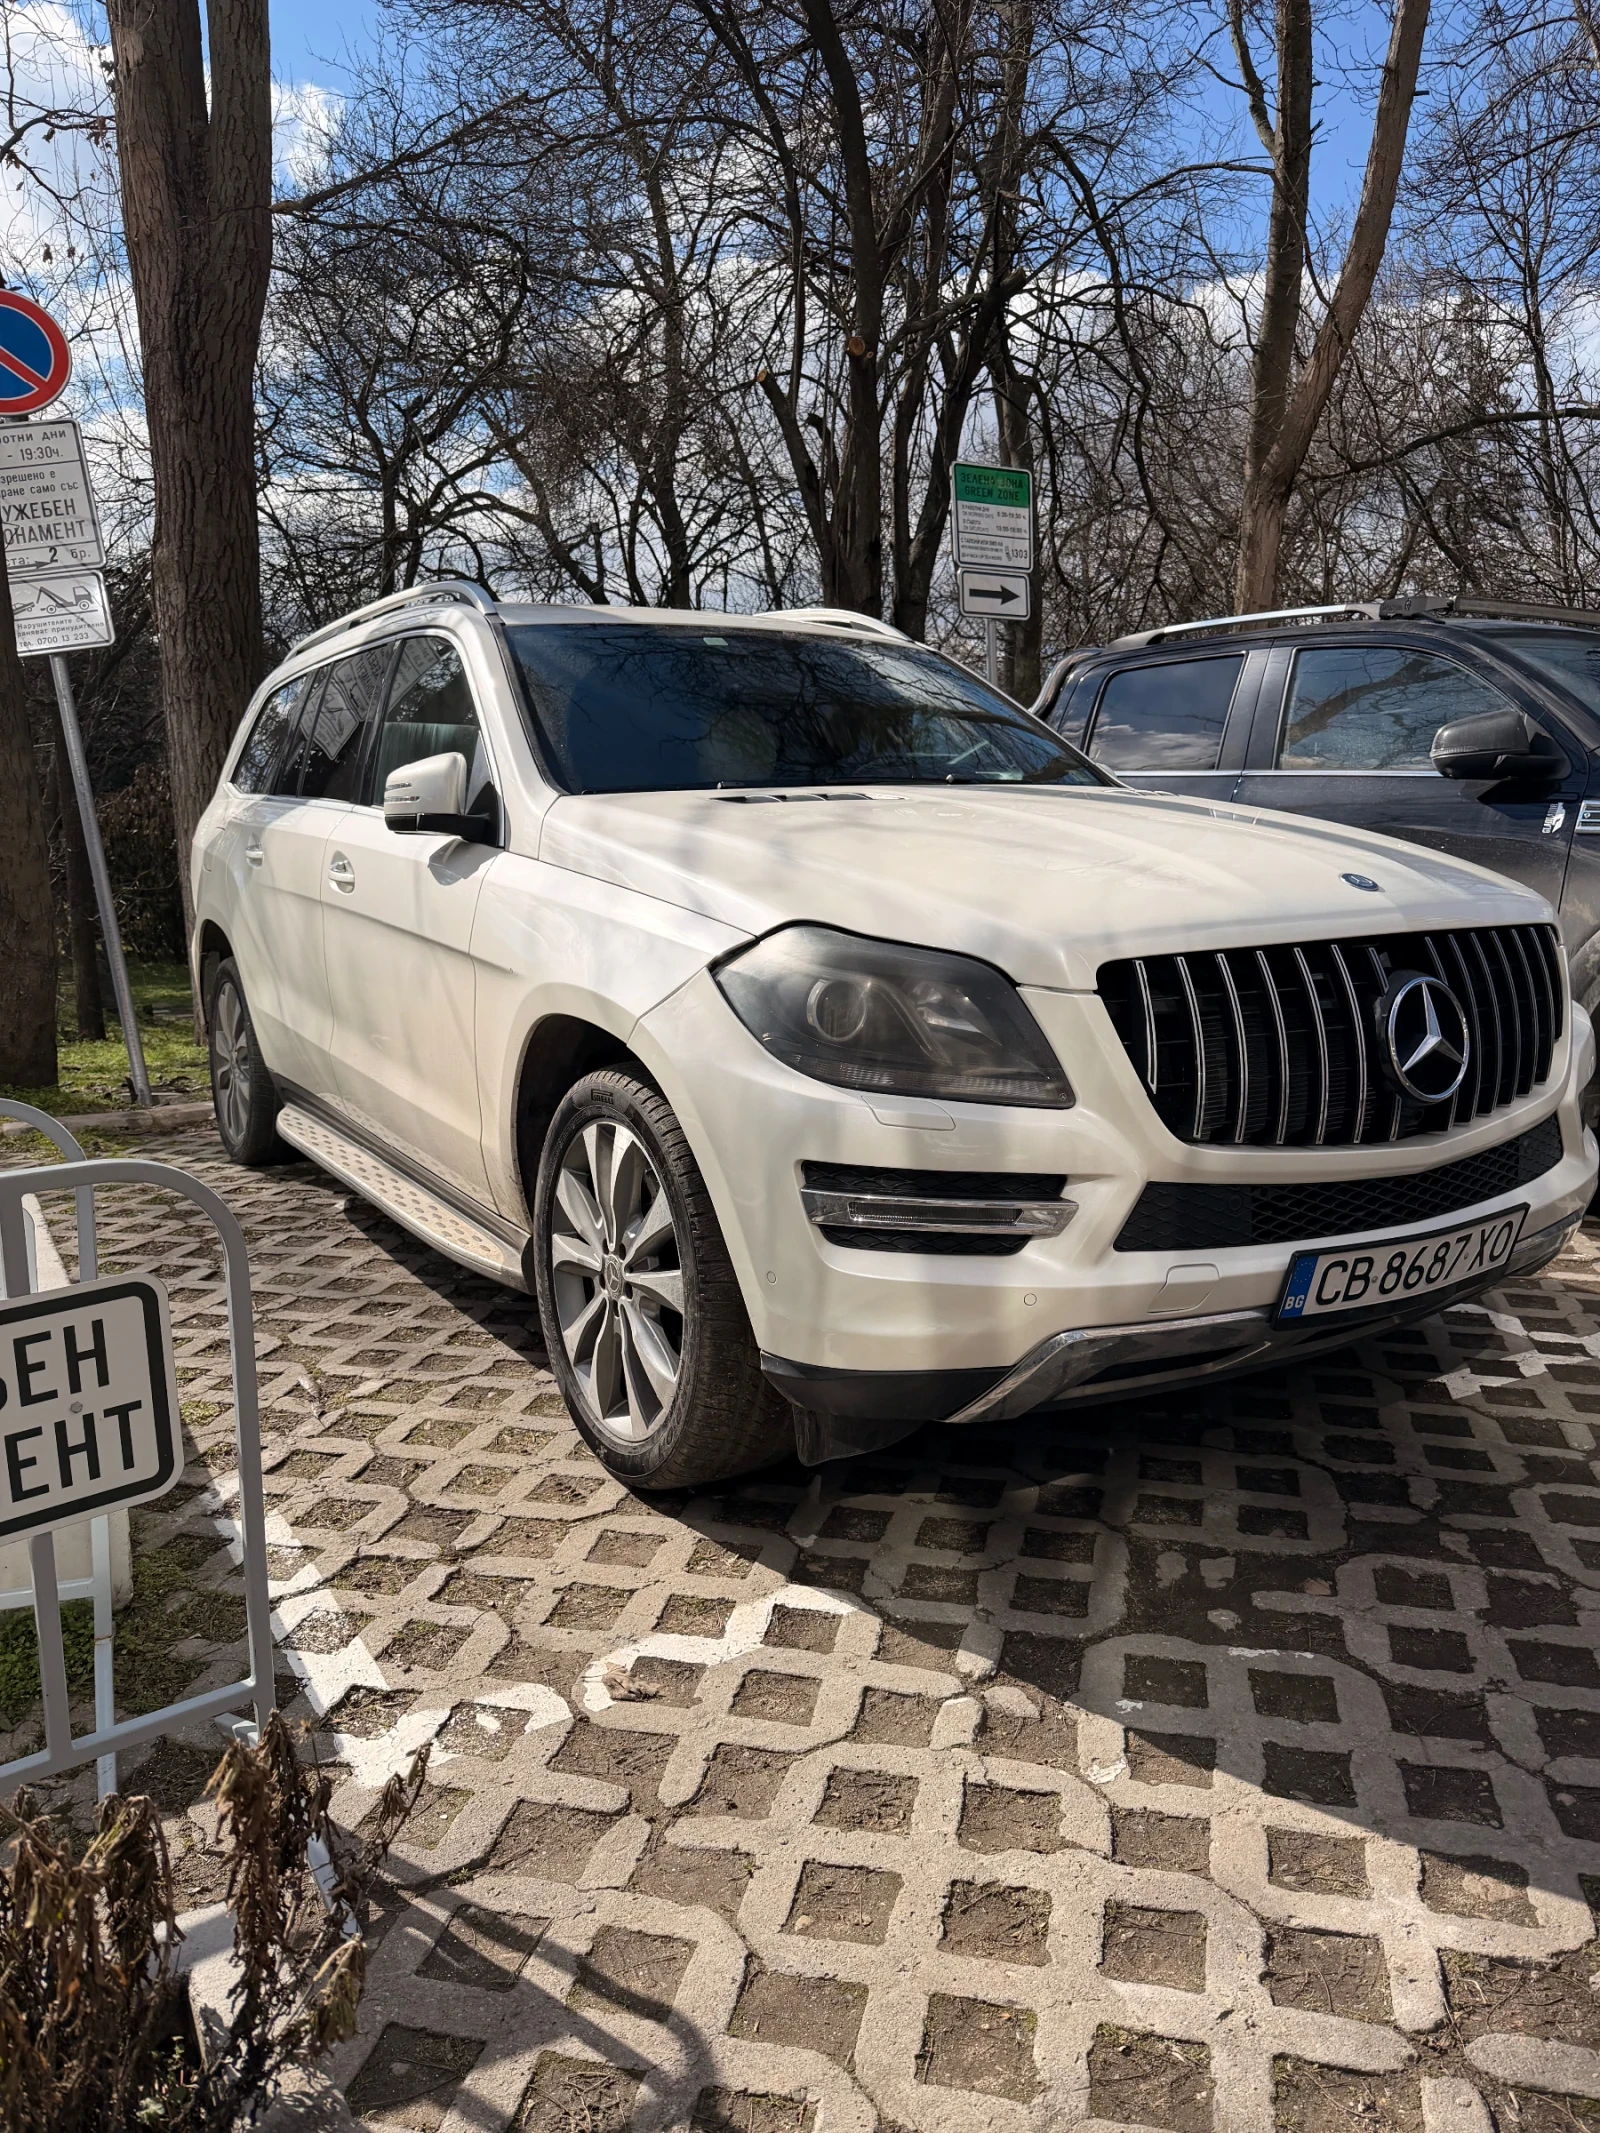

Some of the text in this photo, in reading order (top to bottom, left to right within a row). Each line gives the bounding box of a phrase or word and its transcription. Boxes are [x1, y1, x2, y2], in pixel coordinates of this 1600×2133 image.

[0, 430, 67, 444] отни дни
[0, 470, 56, 486] зрешено е
[0, 481, 79, 500] ране само със
[964, 485, 1020, 501] GREEN ZONE
[2, 498, 76, 522] УЖЕБЕН
[48, 546, 59, 563] 2
[69, 548, 91, 561] бр.
[1011, 548, 1028, 560] 1303
[37, 635, 58, 646] 0700
[62, 634, 70, 643] 13
[73, 631, 90, 642] 233
[1378, 1233, 1473, 1295] 8687
[1284, 1294, 1305, 1310] BG
[0, 1318, 110, 1410] ЕН
[4, 1399, 143, 1504] ЕНТ
